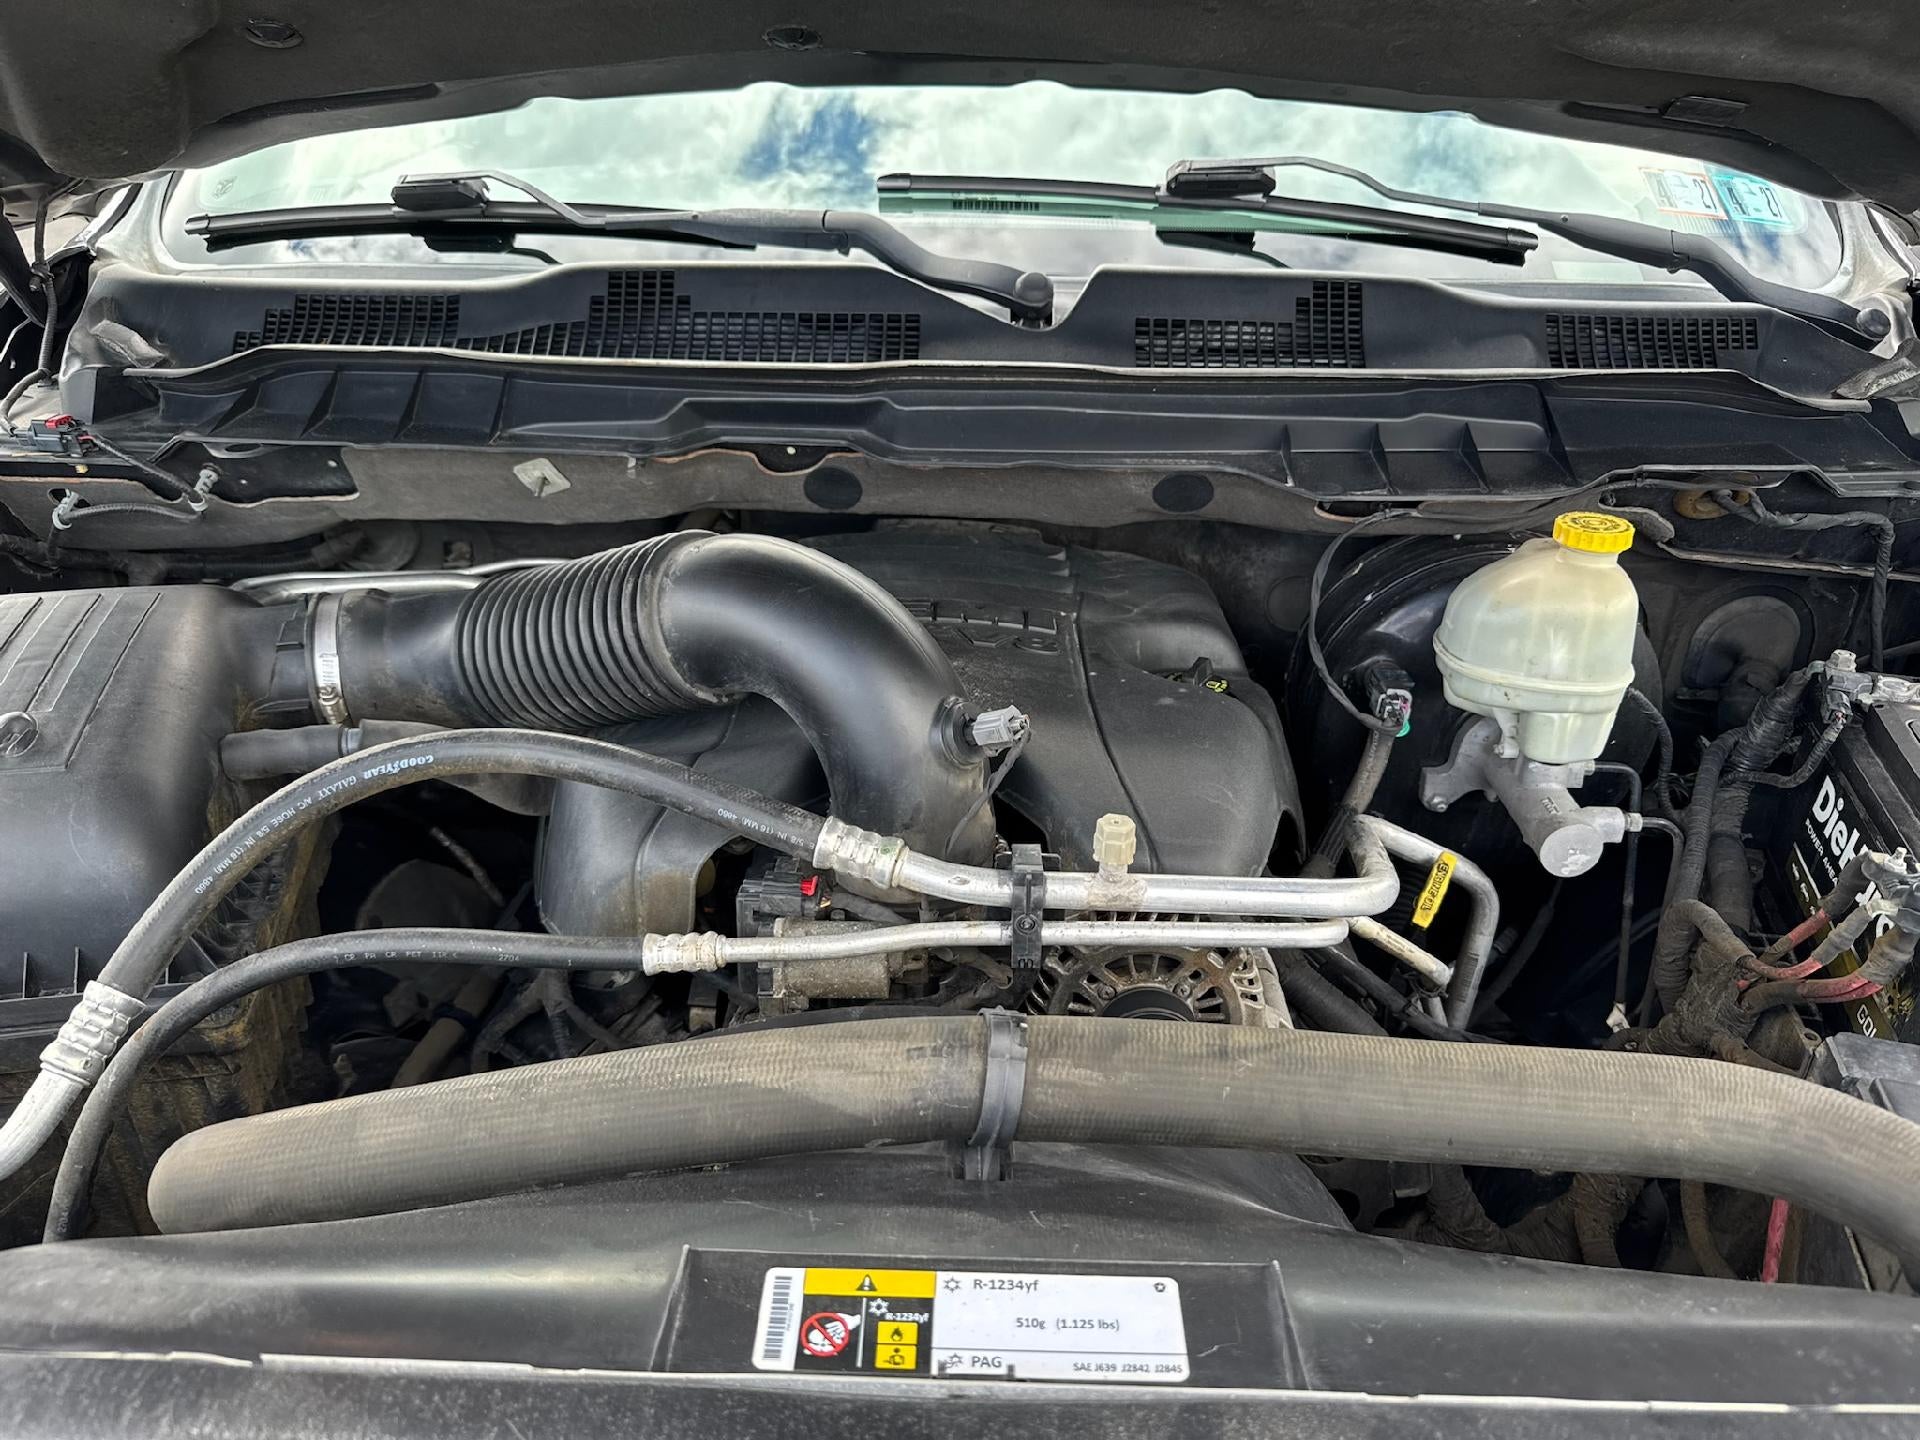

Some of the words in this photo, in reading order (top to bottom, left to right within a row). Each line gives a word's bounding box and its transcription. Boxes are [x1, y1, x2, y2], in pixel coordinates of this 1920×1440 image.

[1692, 178, 1718, 213] 27
[1759, 186, 1783, 218] 27
[363, 754, 434, 780] GOODYEAR
[317, 775, 357, 800] GALAXY
[270, 807, 296, 828] HOSE
[244, 836, 256, 848] IN
[777, 831, 788, 841] IN
[1805, 817, 1824, 857] POWER
[1822, 856, 1839, 888] AHEA
[1428, 862, 1450, 898] ENGINE
[1420, 896, 1434, 911] OIL
[973, 1278, 1039, 1294] R-1234yf
[885, 1312, 929, 1323] R-1234yf
[1016, 1317, 1046, 1330] 510g
[1056, 1318, 1095, 1331] (1.125
[1098, 1318, 1120, 1332] lbs)
[971, 1355, 1002, 1369] PAG
[1073, 1362, 1092, 1372] SAE
